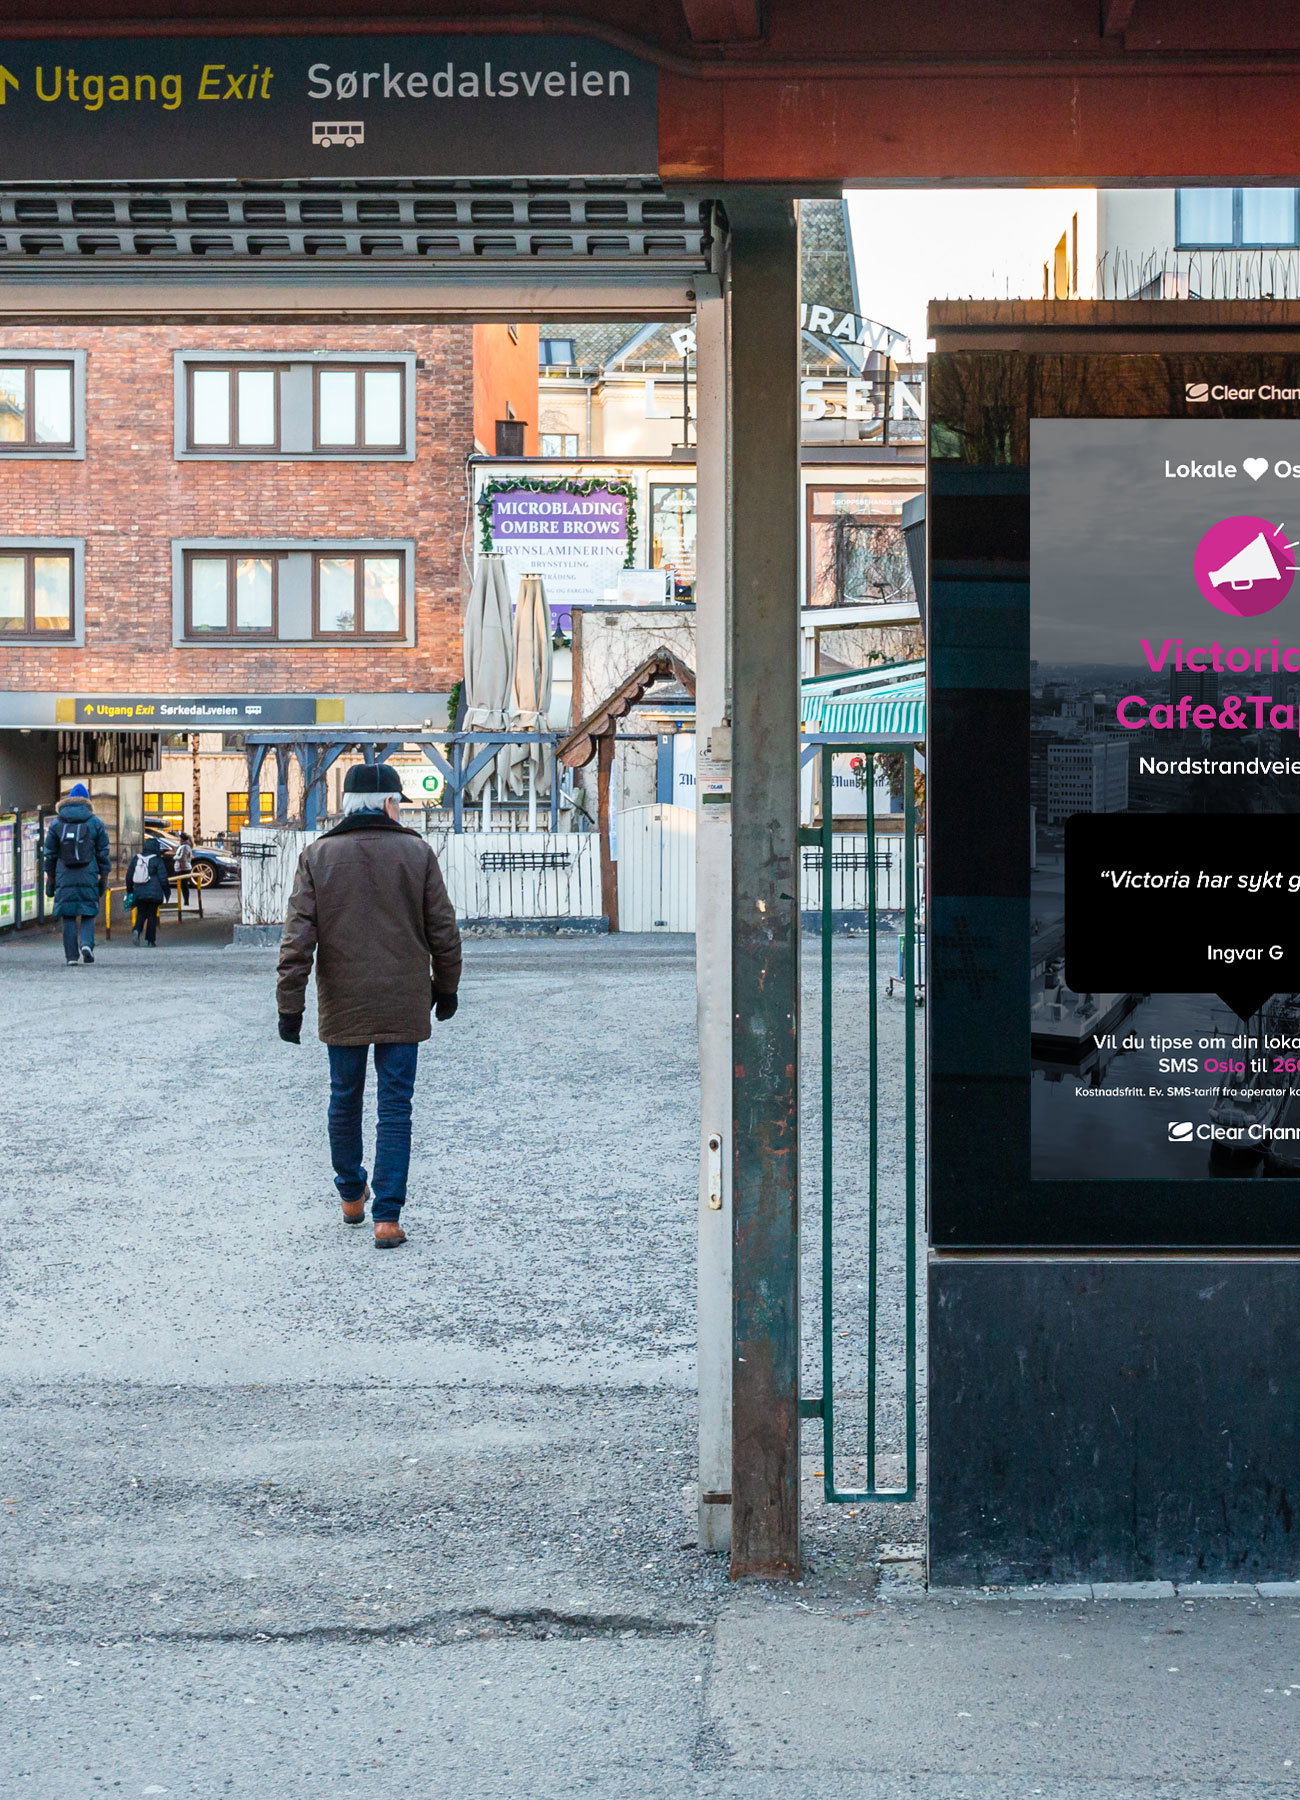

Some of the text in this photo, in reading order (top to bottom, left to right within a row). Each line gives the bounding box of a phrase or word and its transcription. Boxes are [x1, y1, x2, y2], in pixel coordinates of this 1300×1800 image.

[35, 61, 631, 112] Utgang Exit Sørkedalsveien
[1211, 385, 1256, 400] Clear
[1165, 459, 1238, 478] Lokale
[496, 502, 623, 516] MICROBLADING
[500, 520, 620, 534] OMBRE BROWS
[496, 545, 624, 556] BRYNSLAMINERING
[95, 704, 238, 718] Utgang Exit Sørkedalsveien
[1196, 870, 1233, 889] har
[1237, 870, 1284, 893] sykt
[1207, 944, 1284, 964] Ingvar G
[1093, 1034, 1118, 1049] Vil
[1122, 1034, 1145, 1049] du
[1149, 1034, 1193, 1053] tipse
[1198, 1037, 1226, 1049] om
[1231, 1034, 1258, 1049] din
[1158, 1057, 1199, 1073] SMS
[1203, 1058, 1247, 1073] Oslo
[1250, 1058, 1268, 1073] til
[1075, 1086, 1146, 1097] Kostnadsfritt.
[1148, 1086, 1164, 1097] Ev.
[1166, 1086, 1221, 1097] SMS-tariff
[1222, 1086, 1238, 1097] fra
[1240, 1087, 1287, 1099] operatør
[1196, 1123, 1245, 1140] Clear
